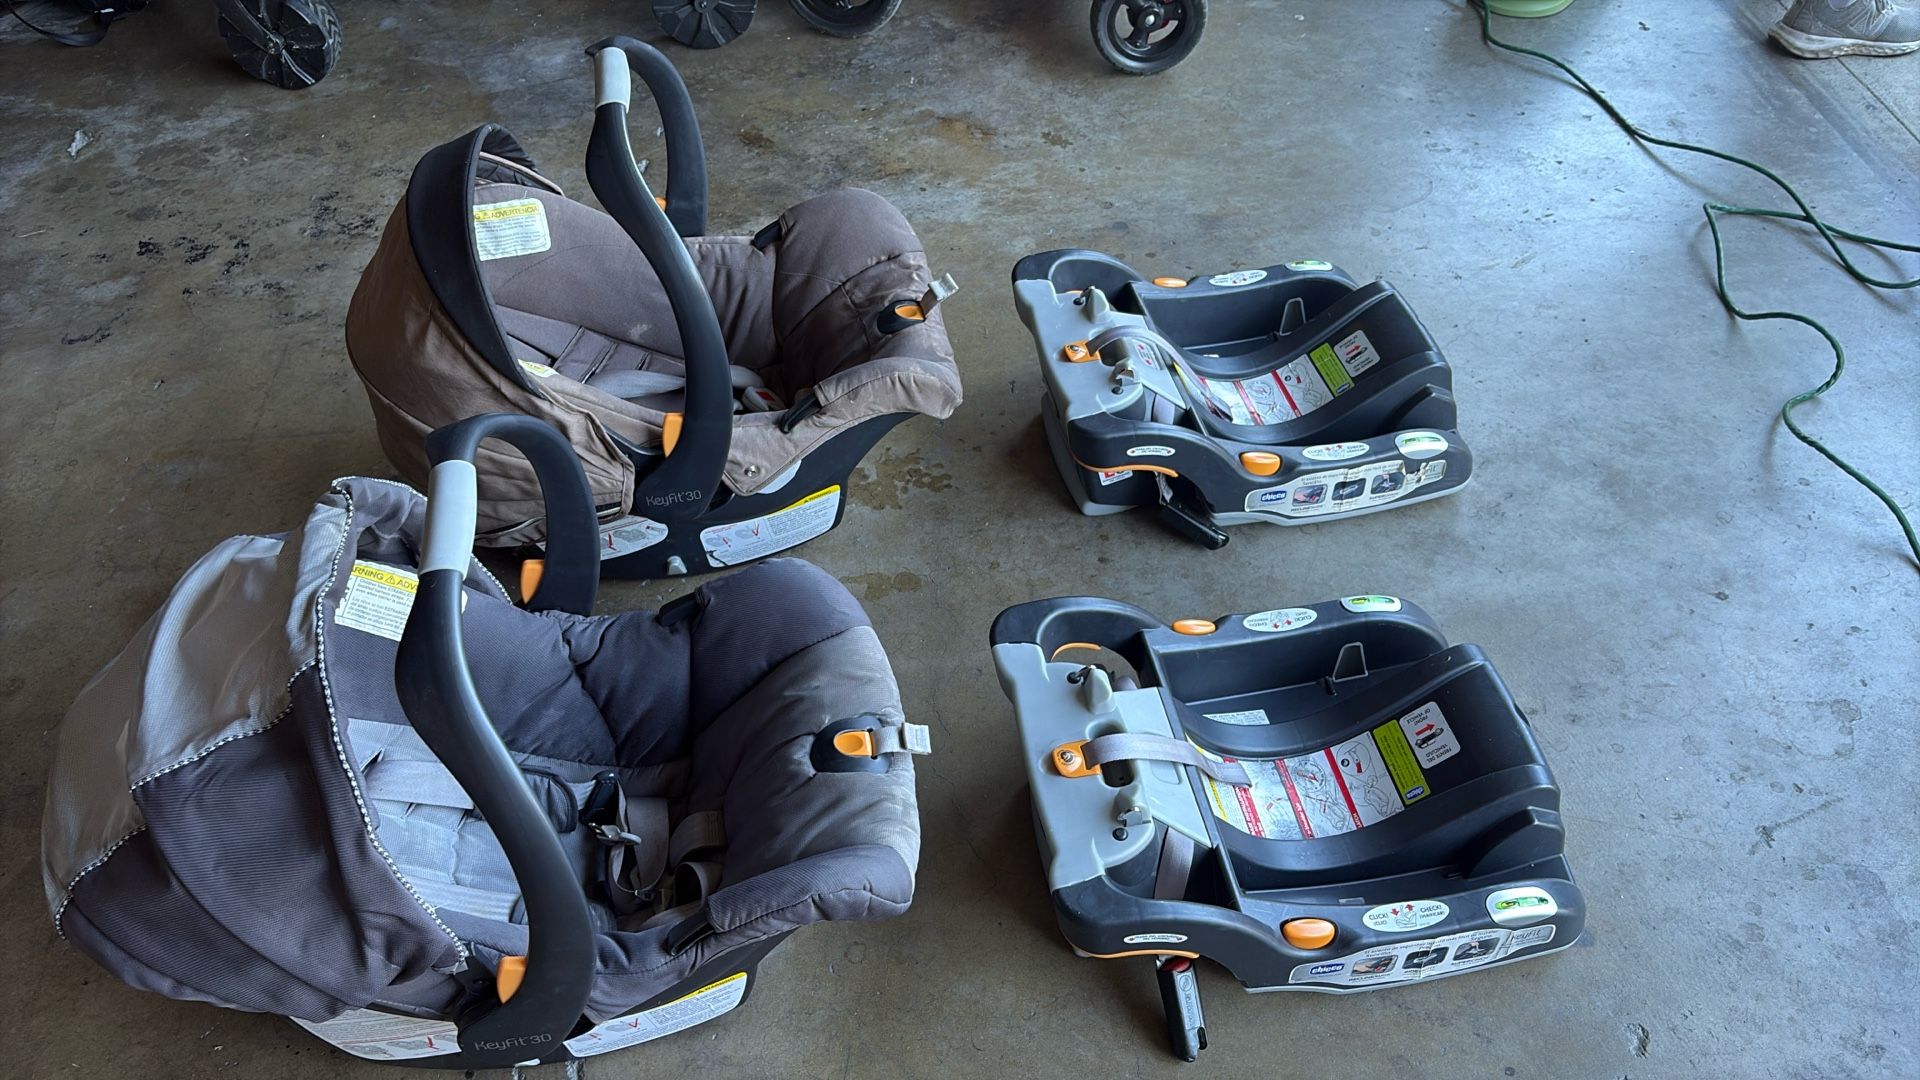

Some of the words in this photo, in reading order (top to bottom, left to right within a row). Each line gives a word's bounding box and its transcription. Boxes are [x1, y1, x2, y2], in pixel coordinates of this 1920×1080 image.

[492, 206, 539, 218] ADVERTENCIA
[686, 490, 701, 500] 30
[1262, 492, 1286, 500] chicco
[352, 565, 384, 581] RNING
[1406, 712, 1424, 724] VEHICLE
[1413, 715, 1429, 725] FRONT
[1352, 812, 1362, 828] LATCH
[1312, 964, 1343, 974] chicco
[475, 1037, 524, 1051] KeyFit
[529, 1034, 552, 1043] 30
